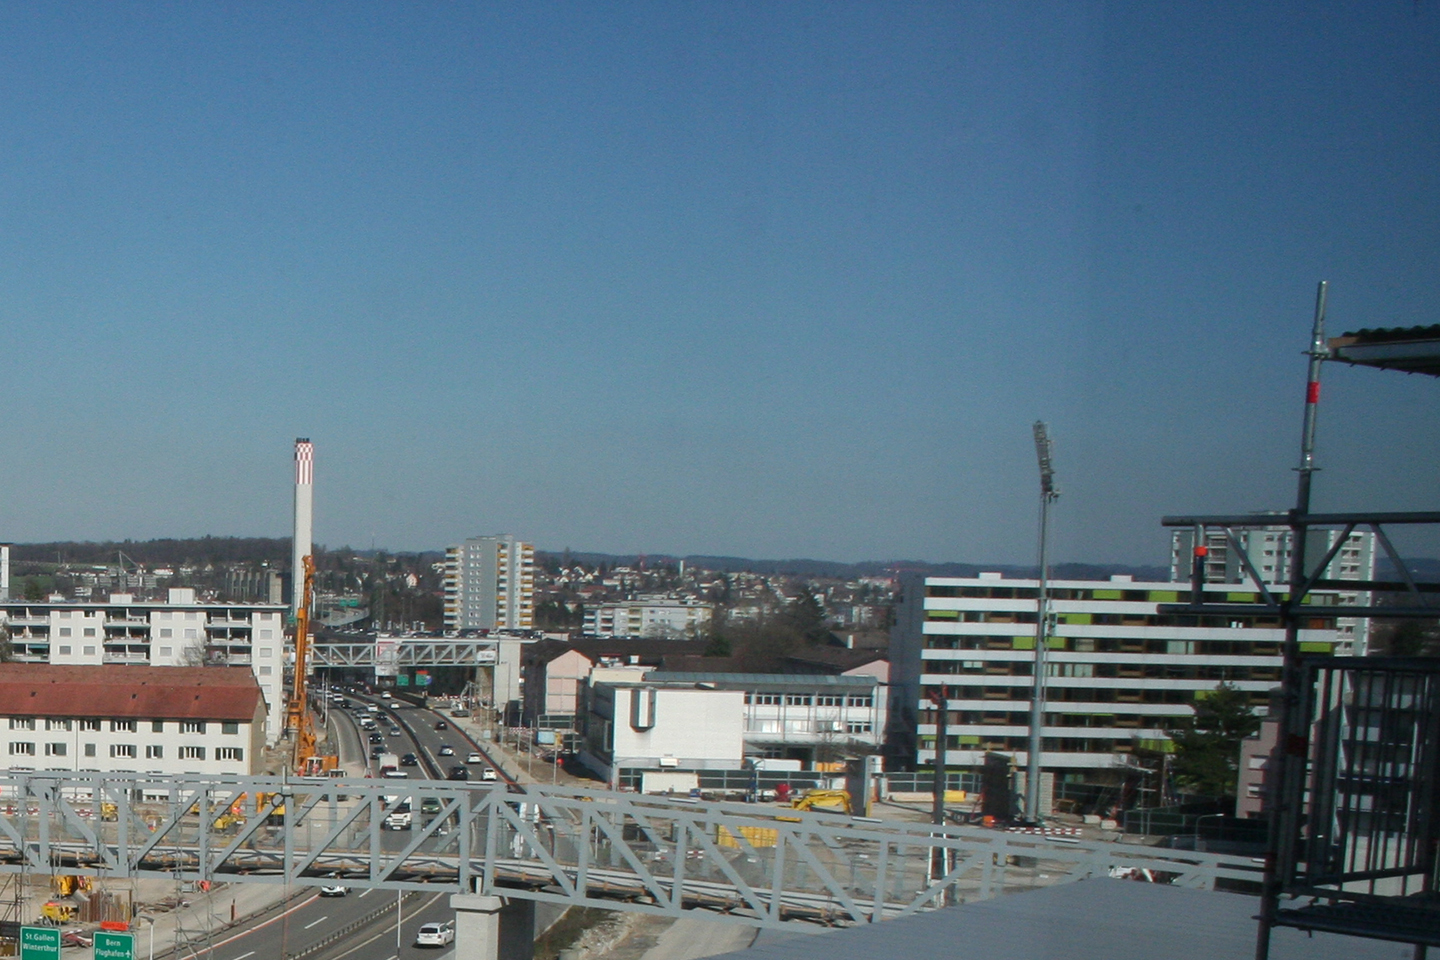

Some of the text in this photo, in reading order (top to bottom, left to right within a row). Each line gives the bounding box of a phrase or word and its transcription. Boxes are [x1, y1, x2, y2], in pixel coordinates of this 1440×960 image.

[105, 938, 121, 947] Bern
[22, 943, 57, 952] Winterthur
[95, 948, 125, 958] Flughafen
